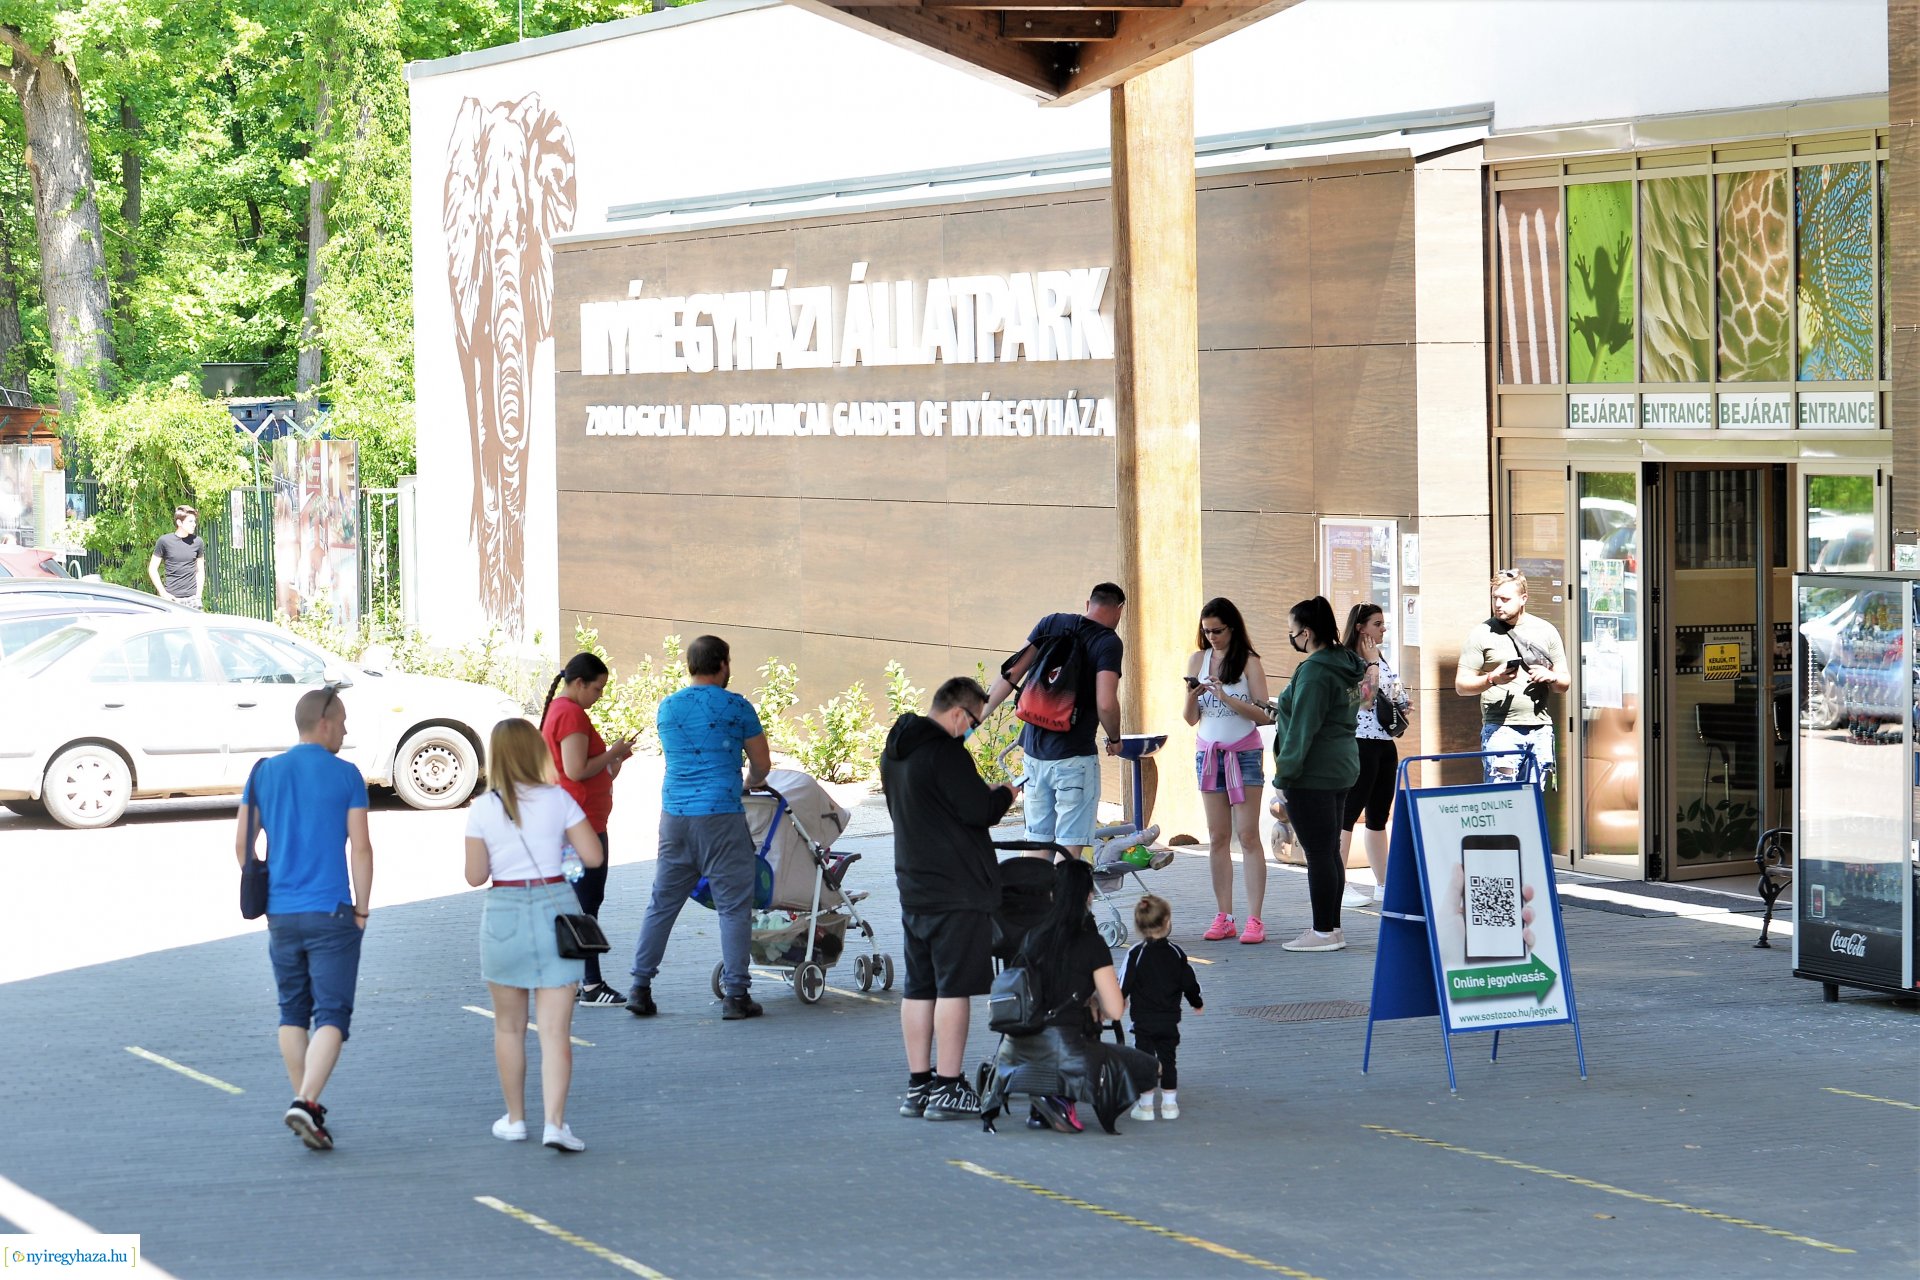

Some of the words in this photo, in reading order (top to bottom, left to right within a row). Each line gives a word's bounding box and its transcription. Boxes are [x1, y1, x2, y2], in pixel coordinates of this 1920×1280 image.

[580, 268, 833, 376] NYÍREGYHÁZI
[840, 261, 1115, 368] ÁLLATPARK
[586, 404, 687, 437] ZOOLOGICAL
[688, 404, 727, 437] AND
[729, 402, 831, 437] BOTANICAL
[832, 401, 916, 437] GARDEN
[919, 401, 948, 437] OF
[951, 390, 1116, 437] NYÍREGYHÁZA
[1571, 398, 1635, 423] BEJÁRAT
[1643, 402, 1712, 424] ENTRANCE
[1720, 397, 1791, 424] BEJÁRAT
[1799, 401, 1875, 424] ENTRANCE
[1438, 803, 1459, 814] Vedd
[1461, 804, 1479, 814] meg
[1481, 799, 1513, 811] ONLINE
[1461, 814, 1496, 829] MOST!
[1453, 975, 1486, 989] Online
[1487, 968, 1549, 989] jegyolvasás.
